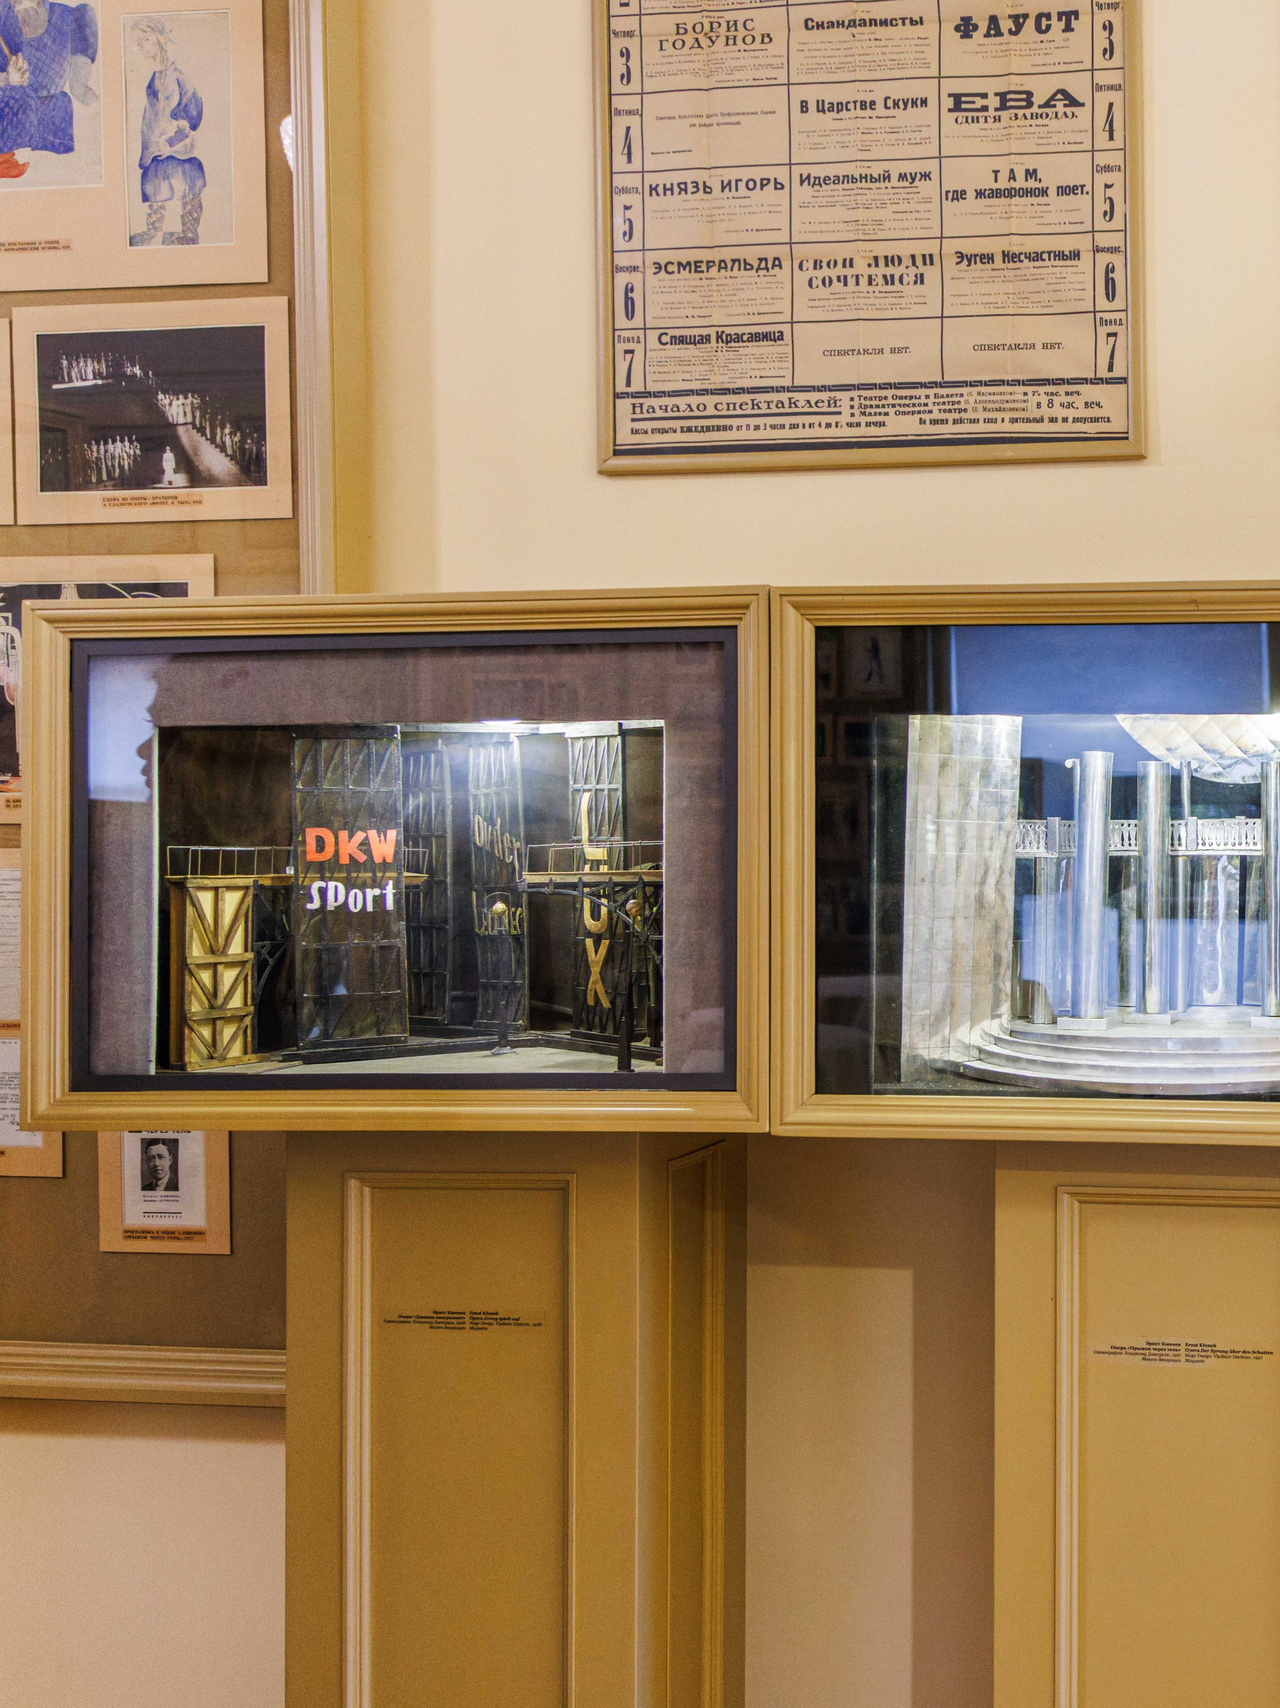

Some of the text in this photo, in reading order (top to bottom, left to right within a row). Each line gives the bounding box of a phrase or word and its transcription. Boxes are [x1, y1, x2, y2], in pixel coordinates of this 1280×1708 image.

[675, 18, 755, 36] БОРИС
[804, 16, 923, 30] Скандалисты
[954, 10, 1079, 39] ФАУСТ
[658, 33, 773, 51] ГОДУНОВ
[1102, 20, 1115, 61] 3
[620, 46, 631, 86] 3
[800, 96, 928, 114] В Царстве Скуки
[947, 88, 1086, 113] ЕВА
[955, 110, 1078, 125] (ДИТЯ ЗАВОДА).
[1102, 102, 1115, 141] 4
[621, 126, 633, 164] 4
[649, 177, 785, 197] КНЯЗЬ ИГОРЬ
[799, 170, 932, 188] Идеальный муж
[945, 184, 1090, 203] где жаворонок поет.
[1103, 183, 1115, 222] 5
[622, 204, 633, 242] 5
[652, 257, 783, 275] ЭСМЕРАЛЬДА
[798, 253, 935, 272] СВОИ ЛЮДИ
[955, 248, 1080, 267] Эуген Несчастный
[807, 272, 925, 289] СОЧТЕМСЯ
[1105, 262, 1116, 302] 6
[624, 282, 635, 321] 6
[657, 330, 785, 348] Спящая Красавица
[973, 342, 1065, 352] СПЕКТАКЛЯ НЕТ.
[823, 346, 912, 357] СПЕКТАКЛЯ НЕТ.
[1106, 332, 1118, 372] 7
[623, 349, 635, 388] 7
[631, 396, 842, 415] Начало спектаклей:
[857, 394, 889, 402] Театре
[933, 392, 964, 400] Балета
[857, 402, 929, 410] Драматическом
[1036, 398, 1103, 410] в 8 час. веч.
[680, 424, 734, 434] ЕЖЕДНЕВНО
[305, 827, 397, 865] DKW
